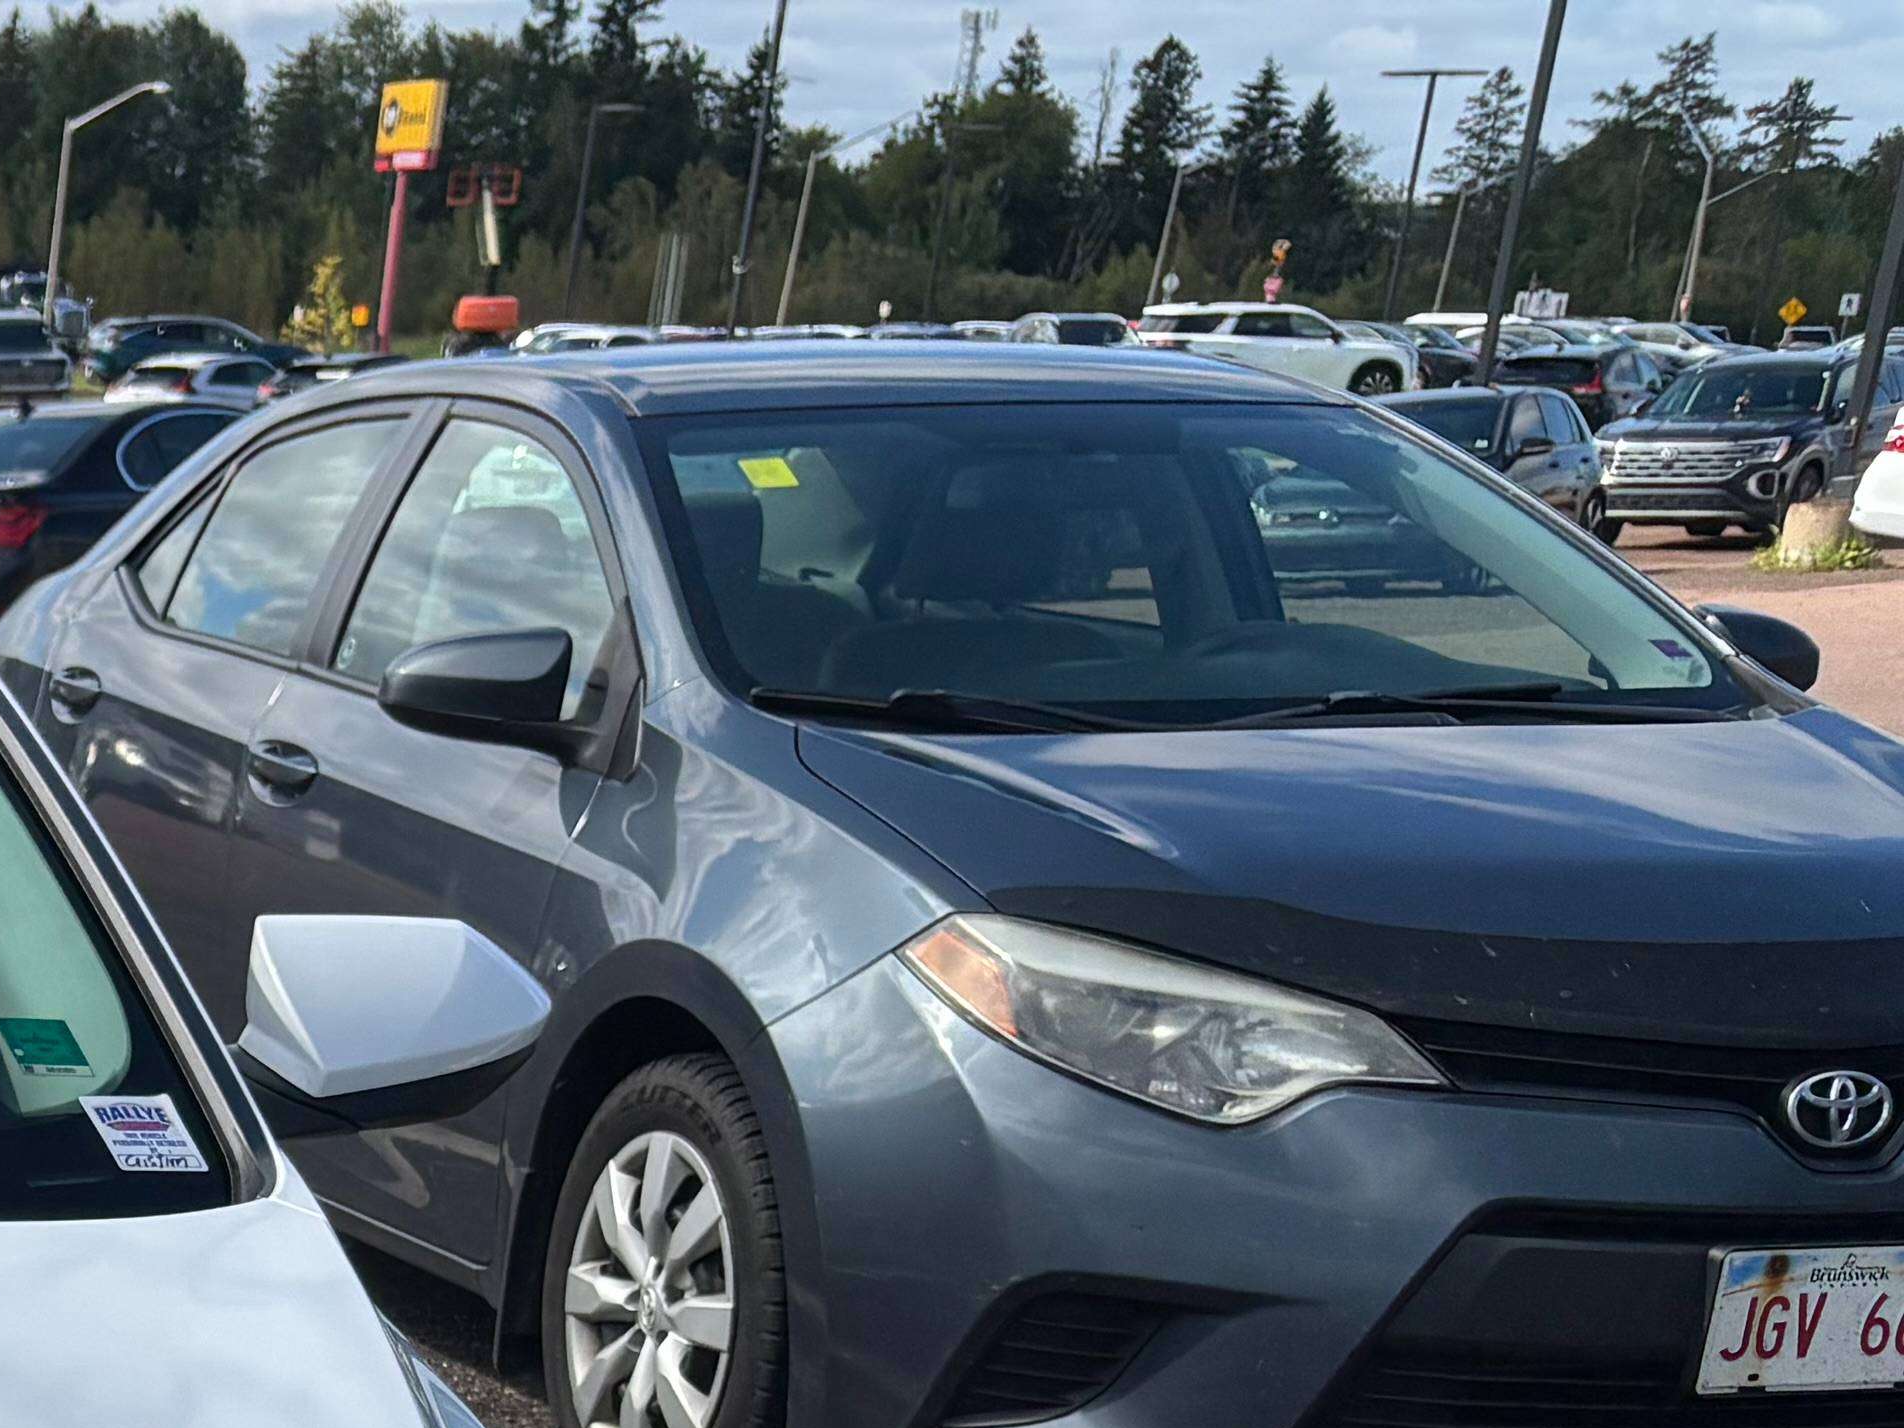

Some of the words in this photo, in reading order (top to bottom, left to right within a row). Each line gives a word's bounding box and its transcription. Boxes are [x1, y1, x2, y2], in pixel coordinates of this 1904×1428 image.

[94, 1106, 172, 1124] RALLYE
[1810, 1267, 1890, 1284] Brunswick
[1719, 1291, 1829, 1362] JGV
